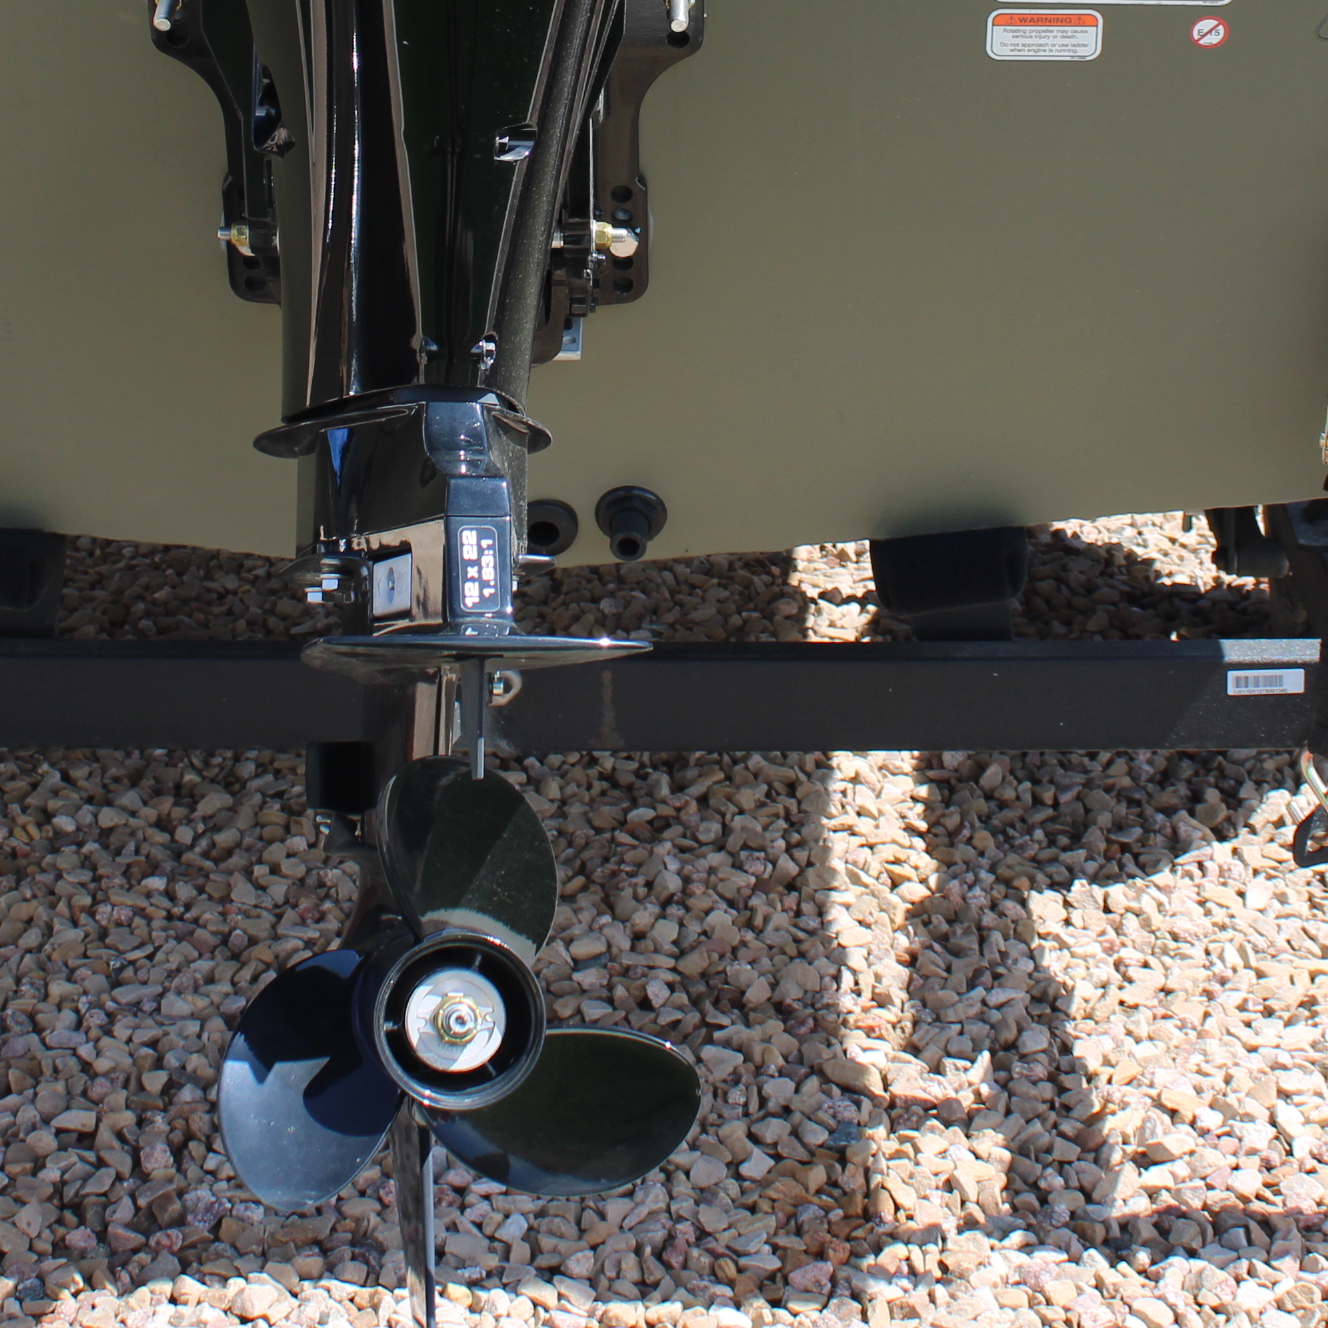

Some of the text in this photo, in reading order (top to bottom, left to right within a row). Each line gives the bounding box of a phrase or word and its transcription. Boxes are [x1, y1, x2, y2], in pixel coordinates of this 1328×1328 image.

[461, 530, 481, 608] 12 x 22
[481, 538, 496, 597] 1.83:1
